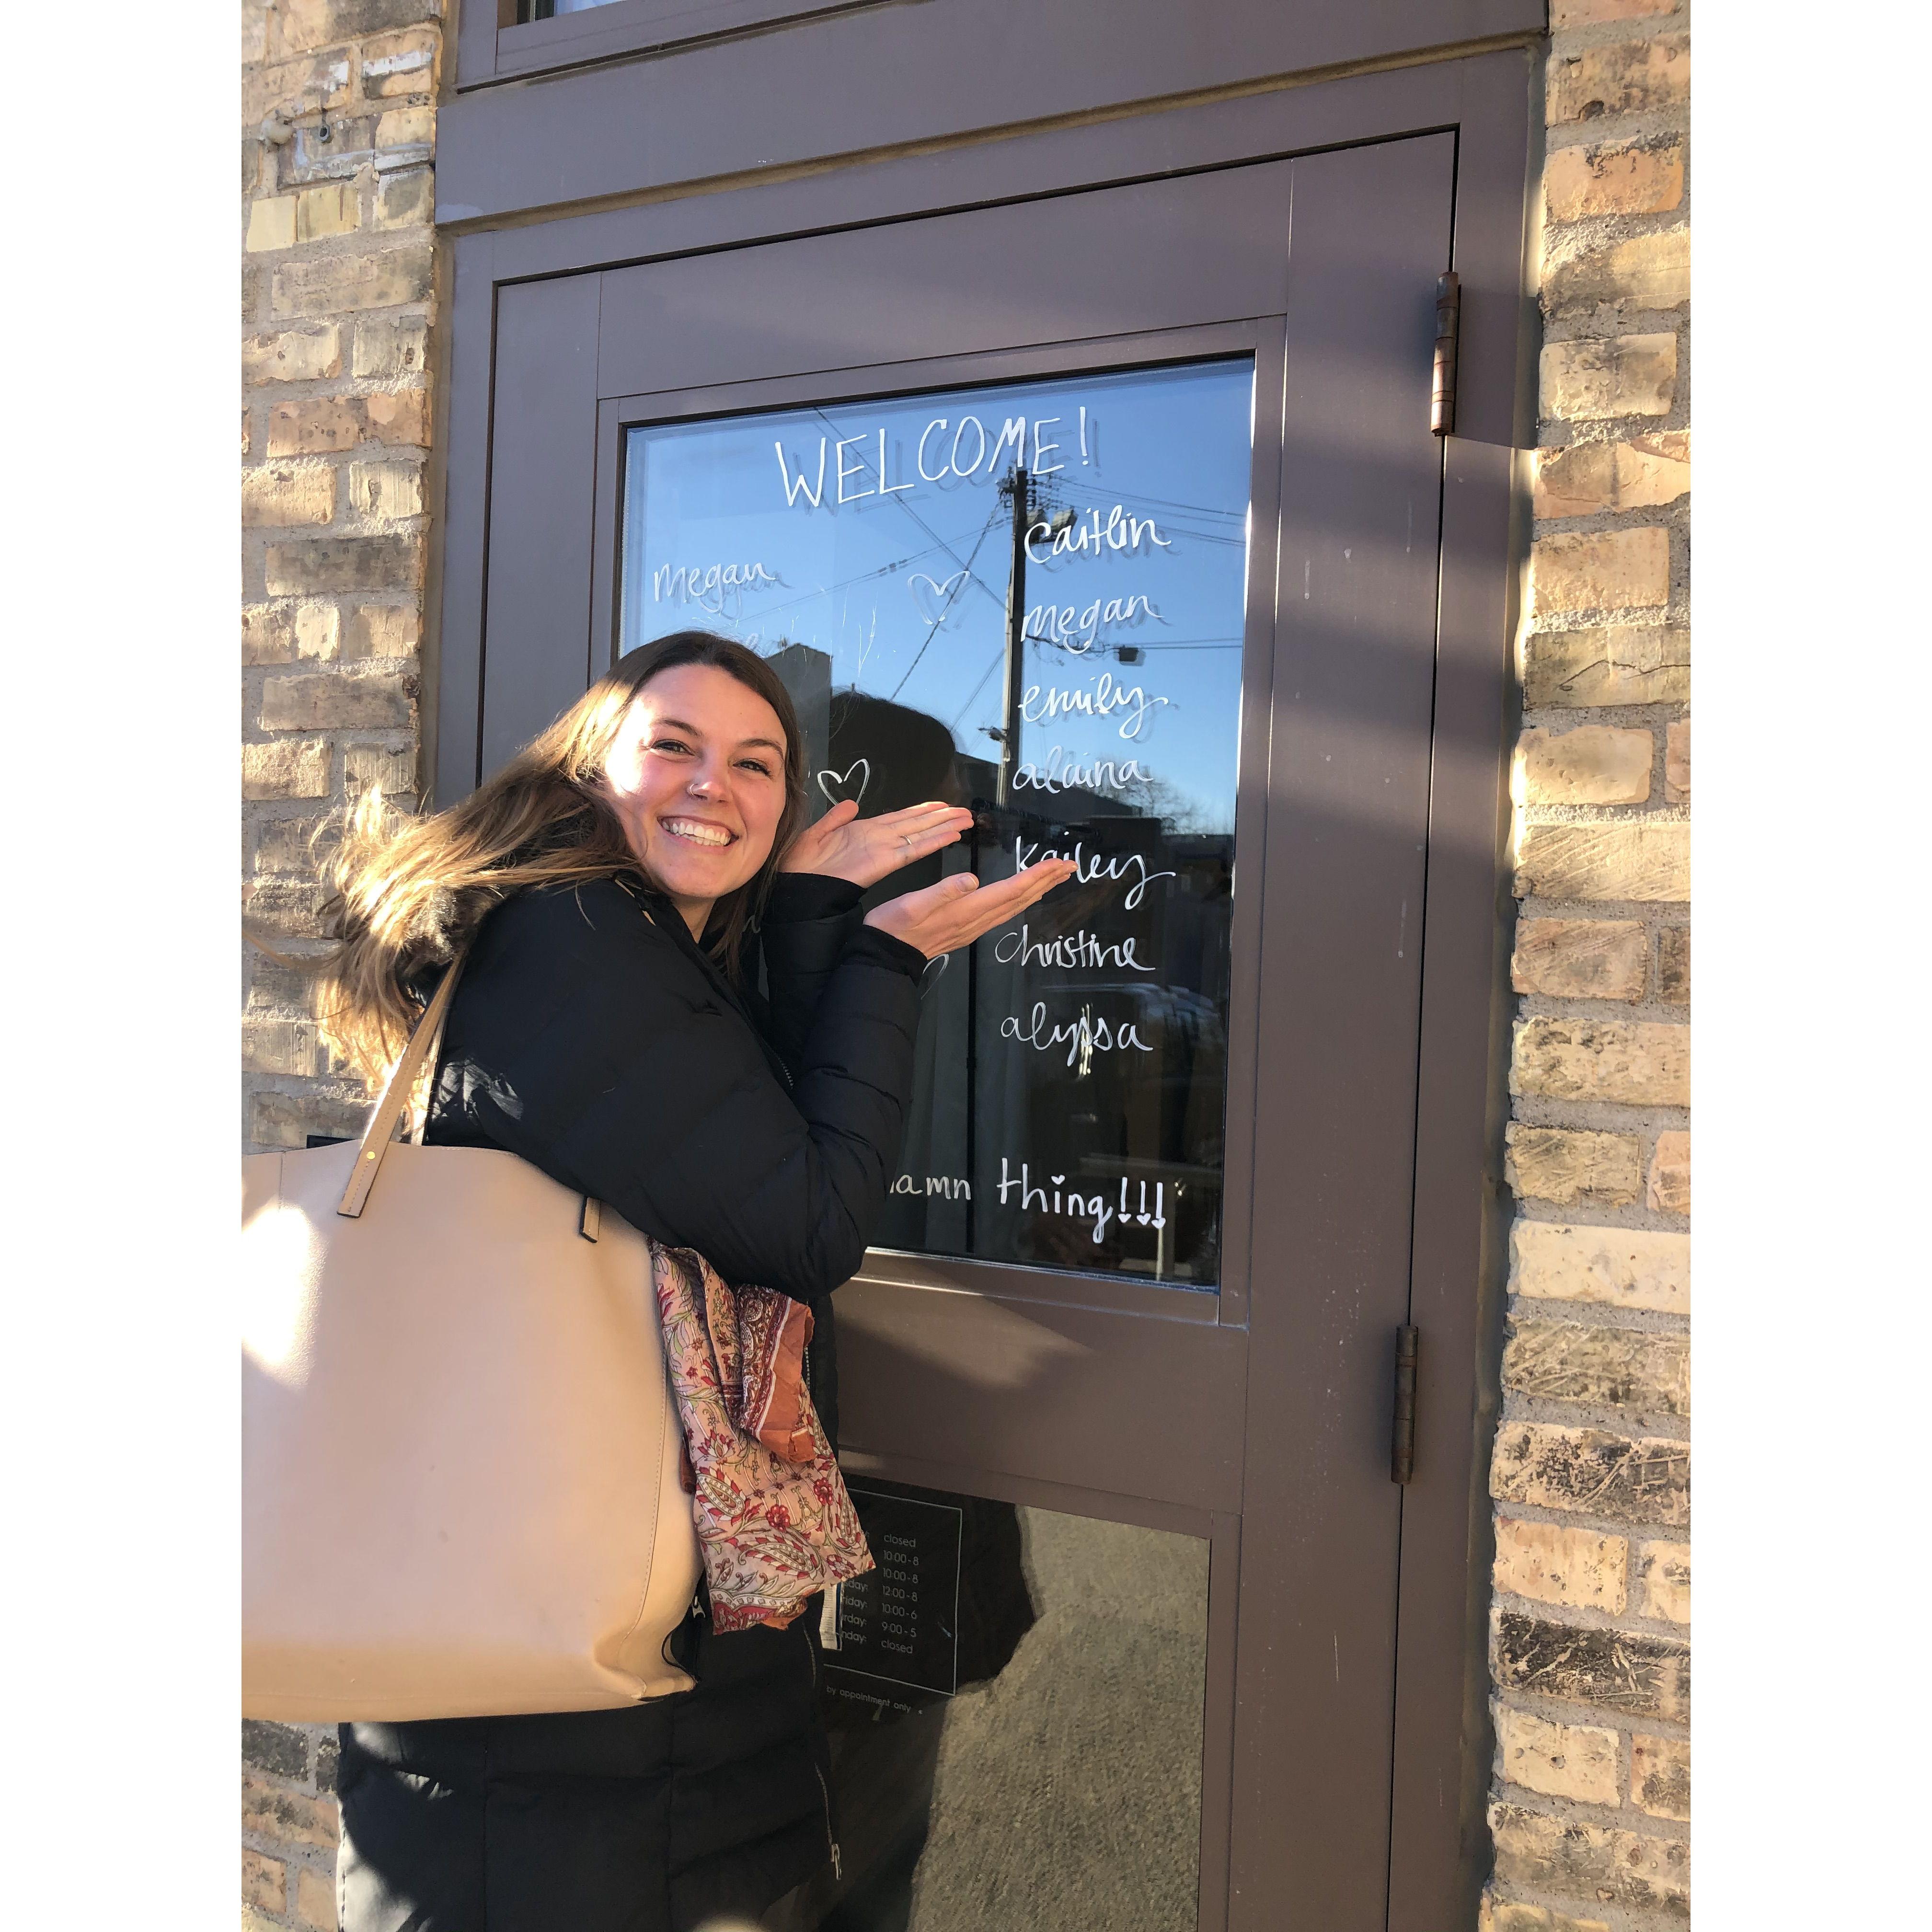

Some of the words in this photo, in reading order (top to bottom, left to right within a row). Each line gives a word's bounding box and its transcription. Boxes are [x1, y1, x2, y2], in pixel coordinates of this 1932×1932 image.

[774, 405, 1090, 508] WELCOME!
[1018, 672, 1169, 739] emily
[1012, 745, 1152, 794] alaina
[1000, 1001, 1153, 1067] alyssa
[889, 1174, 971, 1200] amn
[996, 1157, 1166, 1244] thing!!!
[884, 1534, 916, 1548] closed
[881, 1639, 913, 1654] closed
[826, 1685, 836, 1695] by
[840, 1690, 890, 1706] appointment
[893, 1702, 911, 1714] only
